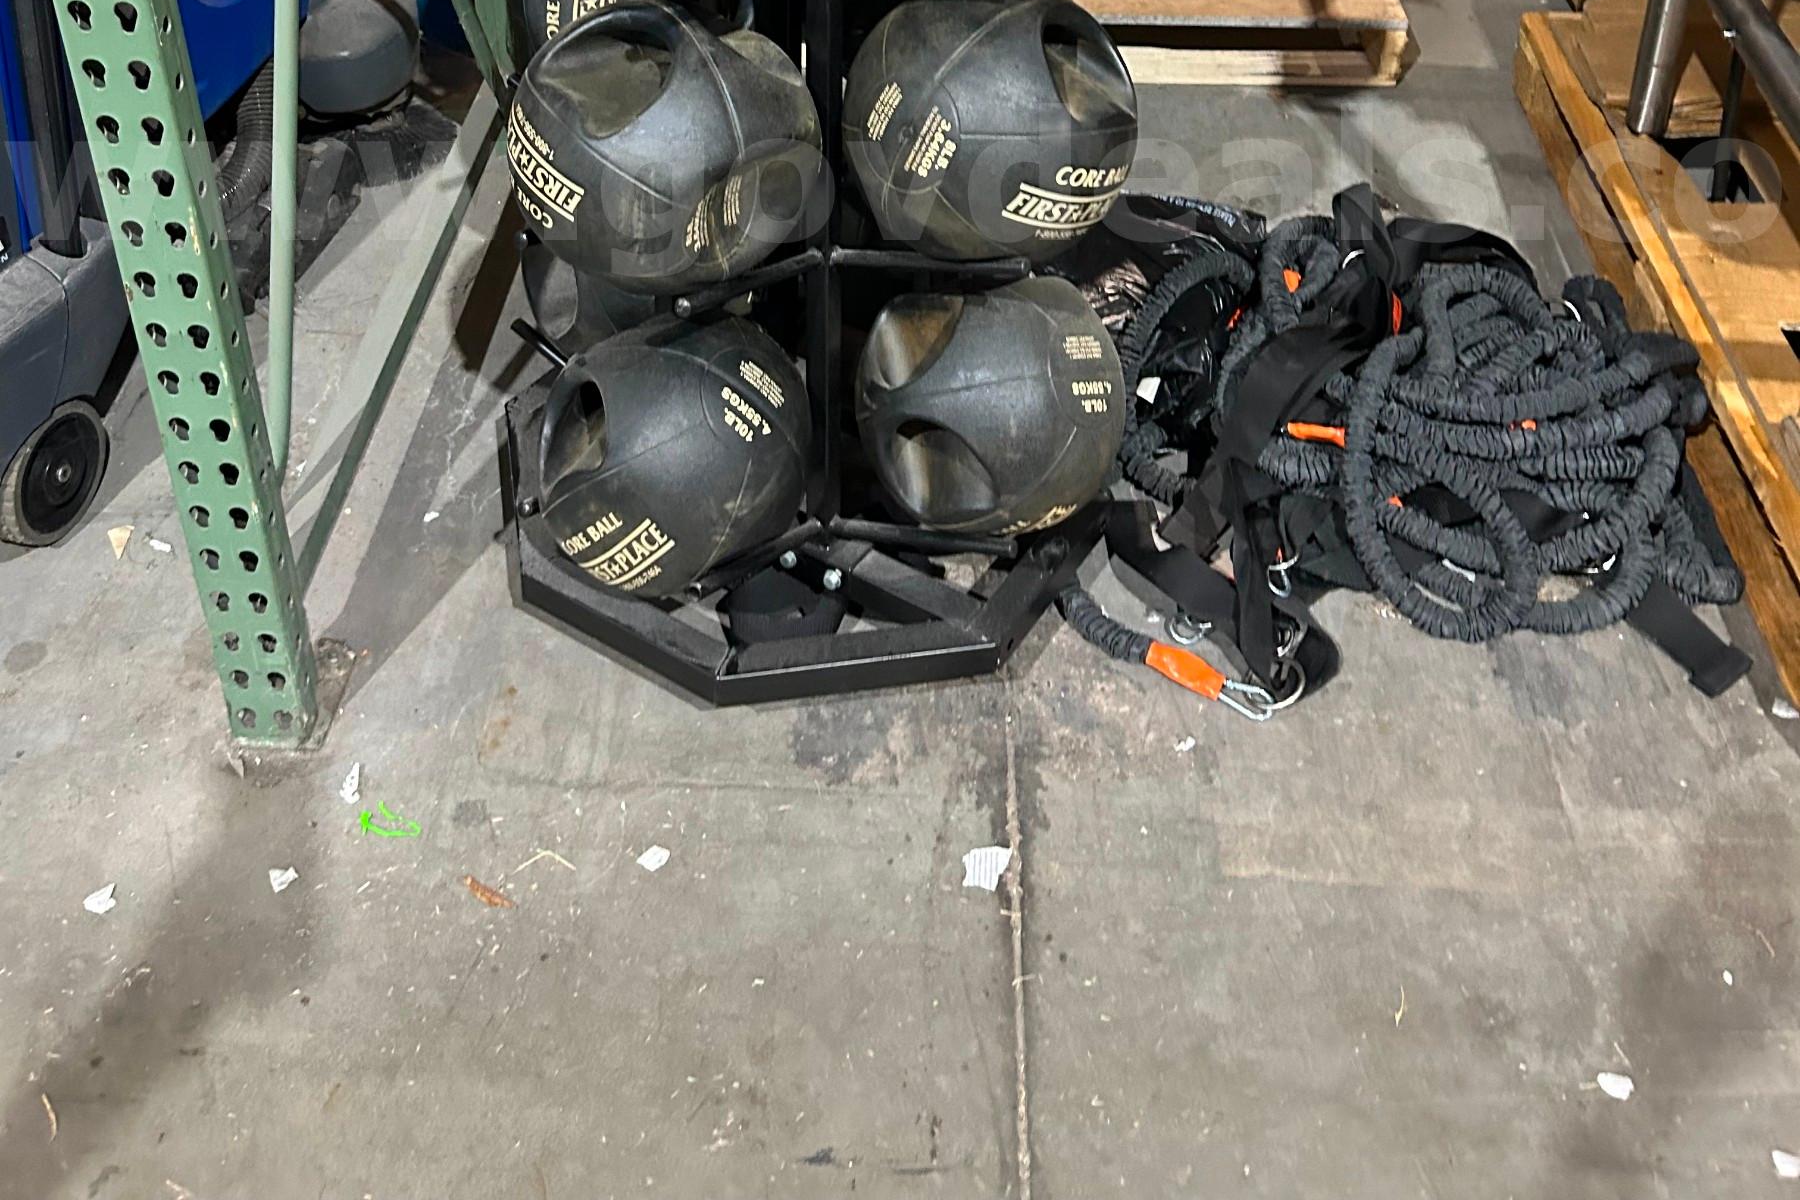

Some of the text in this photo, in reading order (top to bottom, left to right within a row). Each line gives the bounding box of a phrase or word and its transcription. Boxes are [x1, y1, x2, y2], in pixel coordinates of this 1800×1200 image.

[546, 0, 561, 40] ORE
[522, 155, 583, 214] FIRST
[1055, 165, 1106, 188] CORE
[1006, 191, 1075, 223] FIRST
[586, 511, 623, 543] BALL
[613, 522, 668, 572] PLACE
